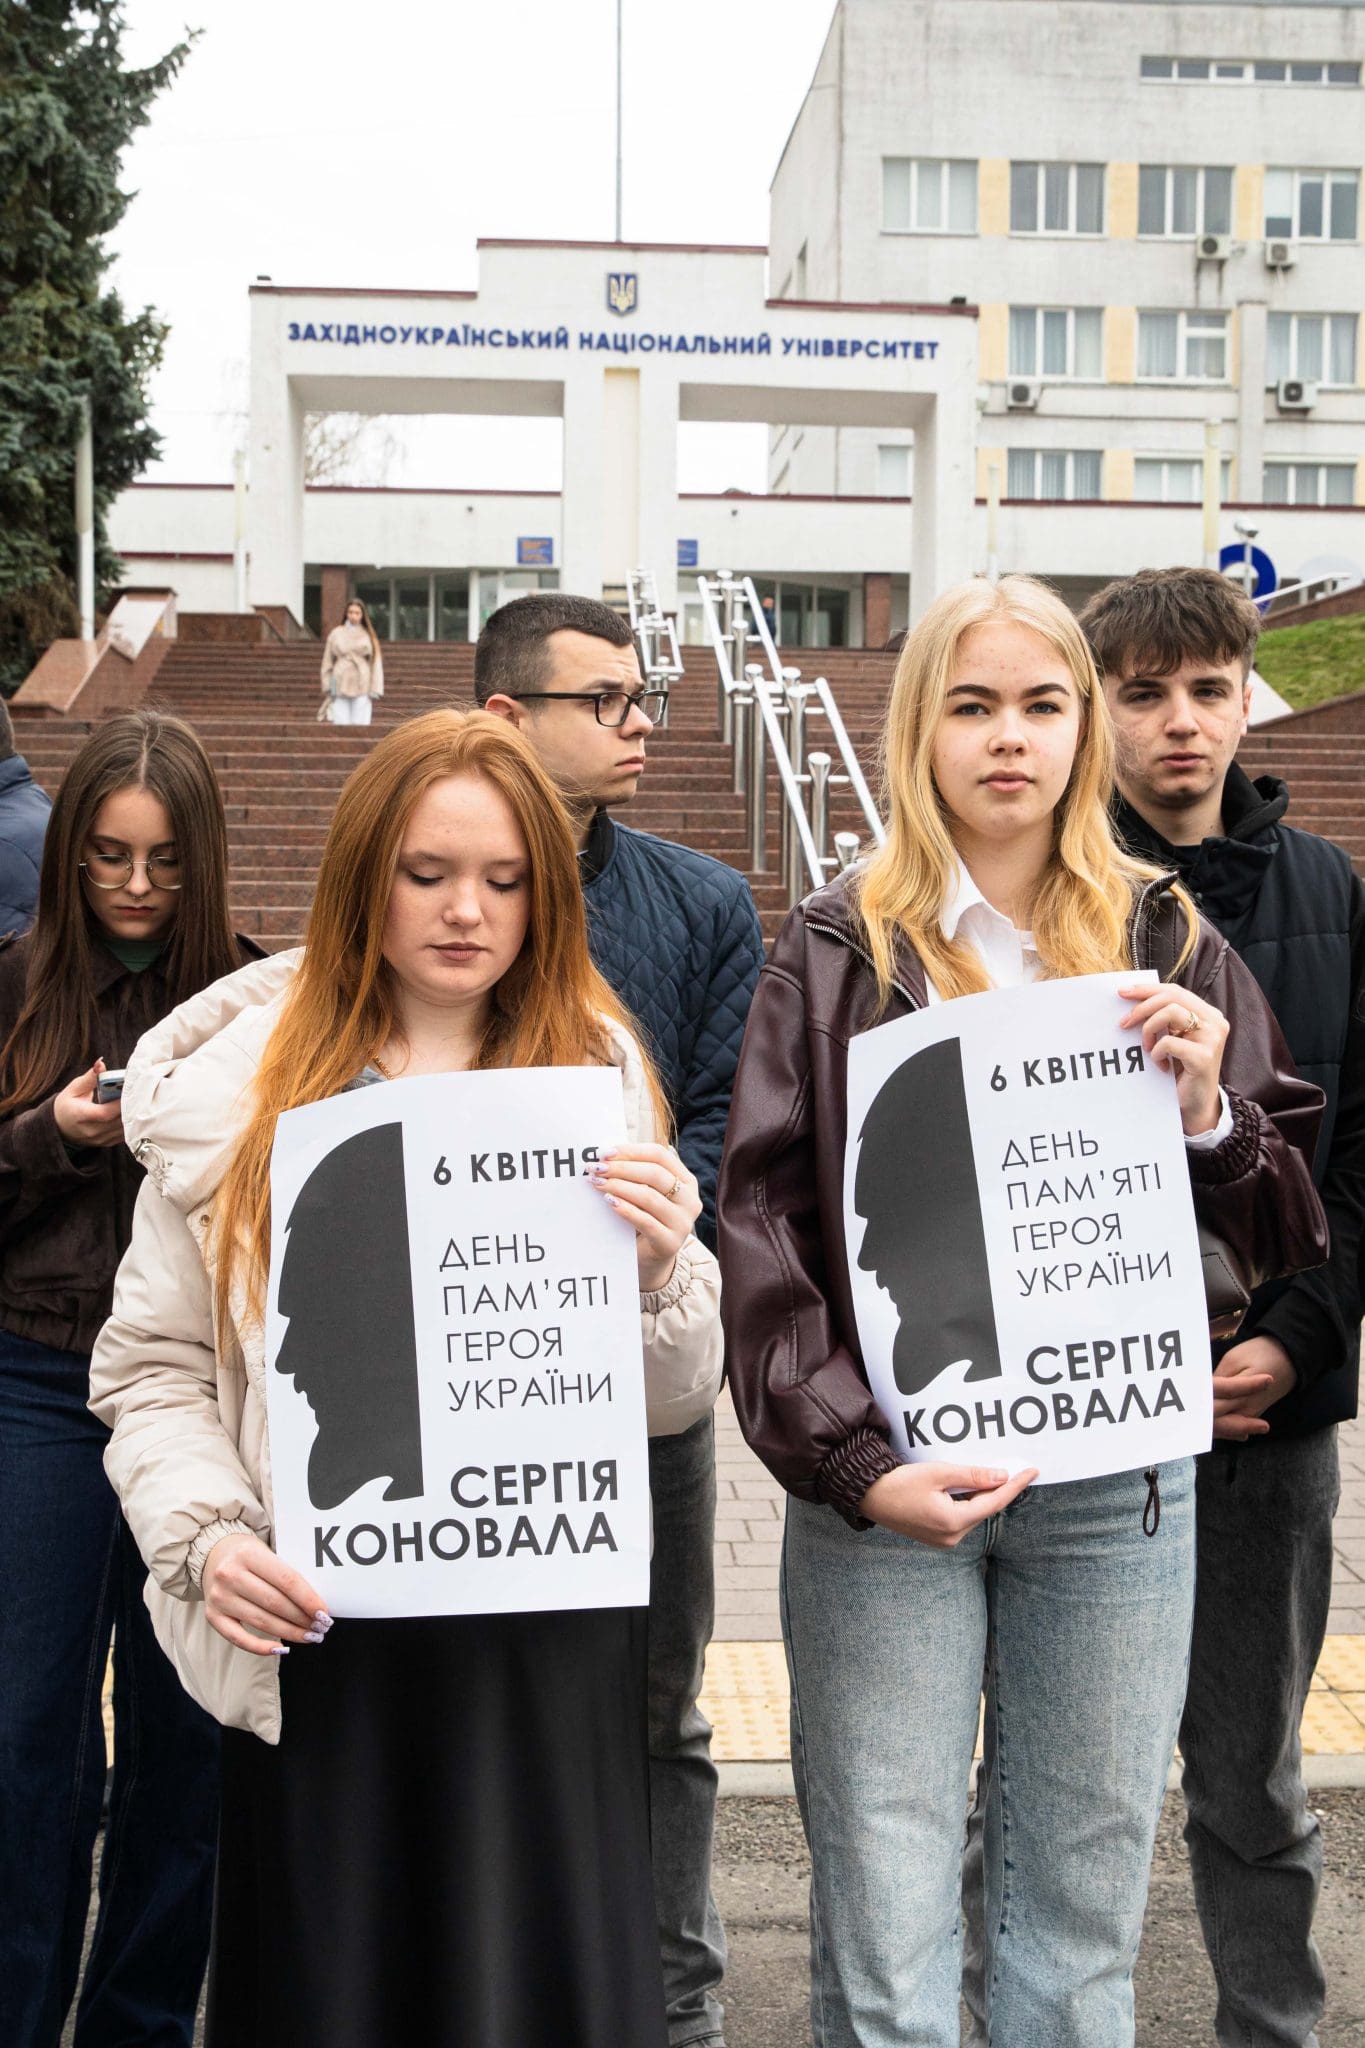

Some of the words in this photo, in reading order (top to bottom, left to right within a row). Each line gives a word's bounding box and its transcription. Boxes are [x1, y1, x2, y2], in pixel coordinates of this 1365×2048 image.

[288, 322, 569, 349] ЗАХІДНОУКРАЇНСЬКИЙ
[579, 332, 771, 355] НАЦІОНАЛЬНИЙ
[782, 338, 939, 359] УНІВЕРСИТЕТ
[990, 1064, 1007, 1092] 6
[1023, 1044, 1145, 1088] КВІТНЯ
[433, 1155, 452, 1186] 6
[1001, 1129, 1099, 1172] ДЕНЬ
[1006, 1162, 1161, 1210] ПАМ'ЯТІ
[439, 1233, 545, 1273] ДЕНЬ
[1012, 1212, 1122, 1253] ГЕРОЯ
[443, 1275, 608, 1316] ПАМ'ЯТІ
[1016, 1251, 1172, 1297] УКРАЇНИ
[446, 1326, 563, 1363] ГЕРОЯ
[1026, 1329, 1183, 1386] СЕРГІЯ
[447, 1368, 612, 1412] УКРАЇНИ
[902, 1377, 1186, 1449] КОНОВАЛА
[450, 1459, 619, 1509] СЕРГІЯ
[313, 1511, 620, 1568] КОНОВАЛА
